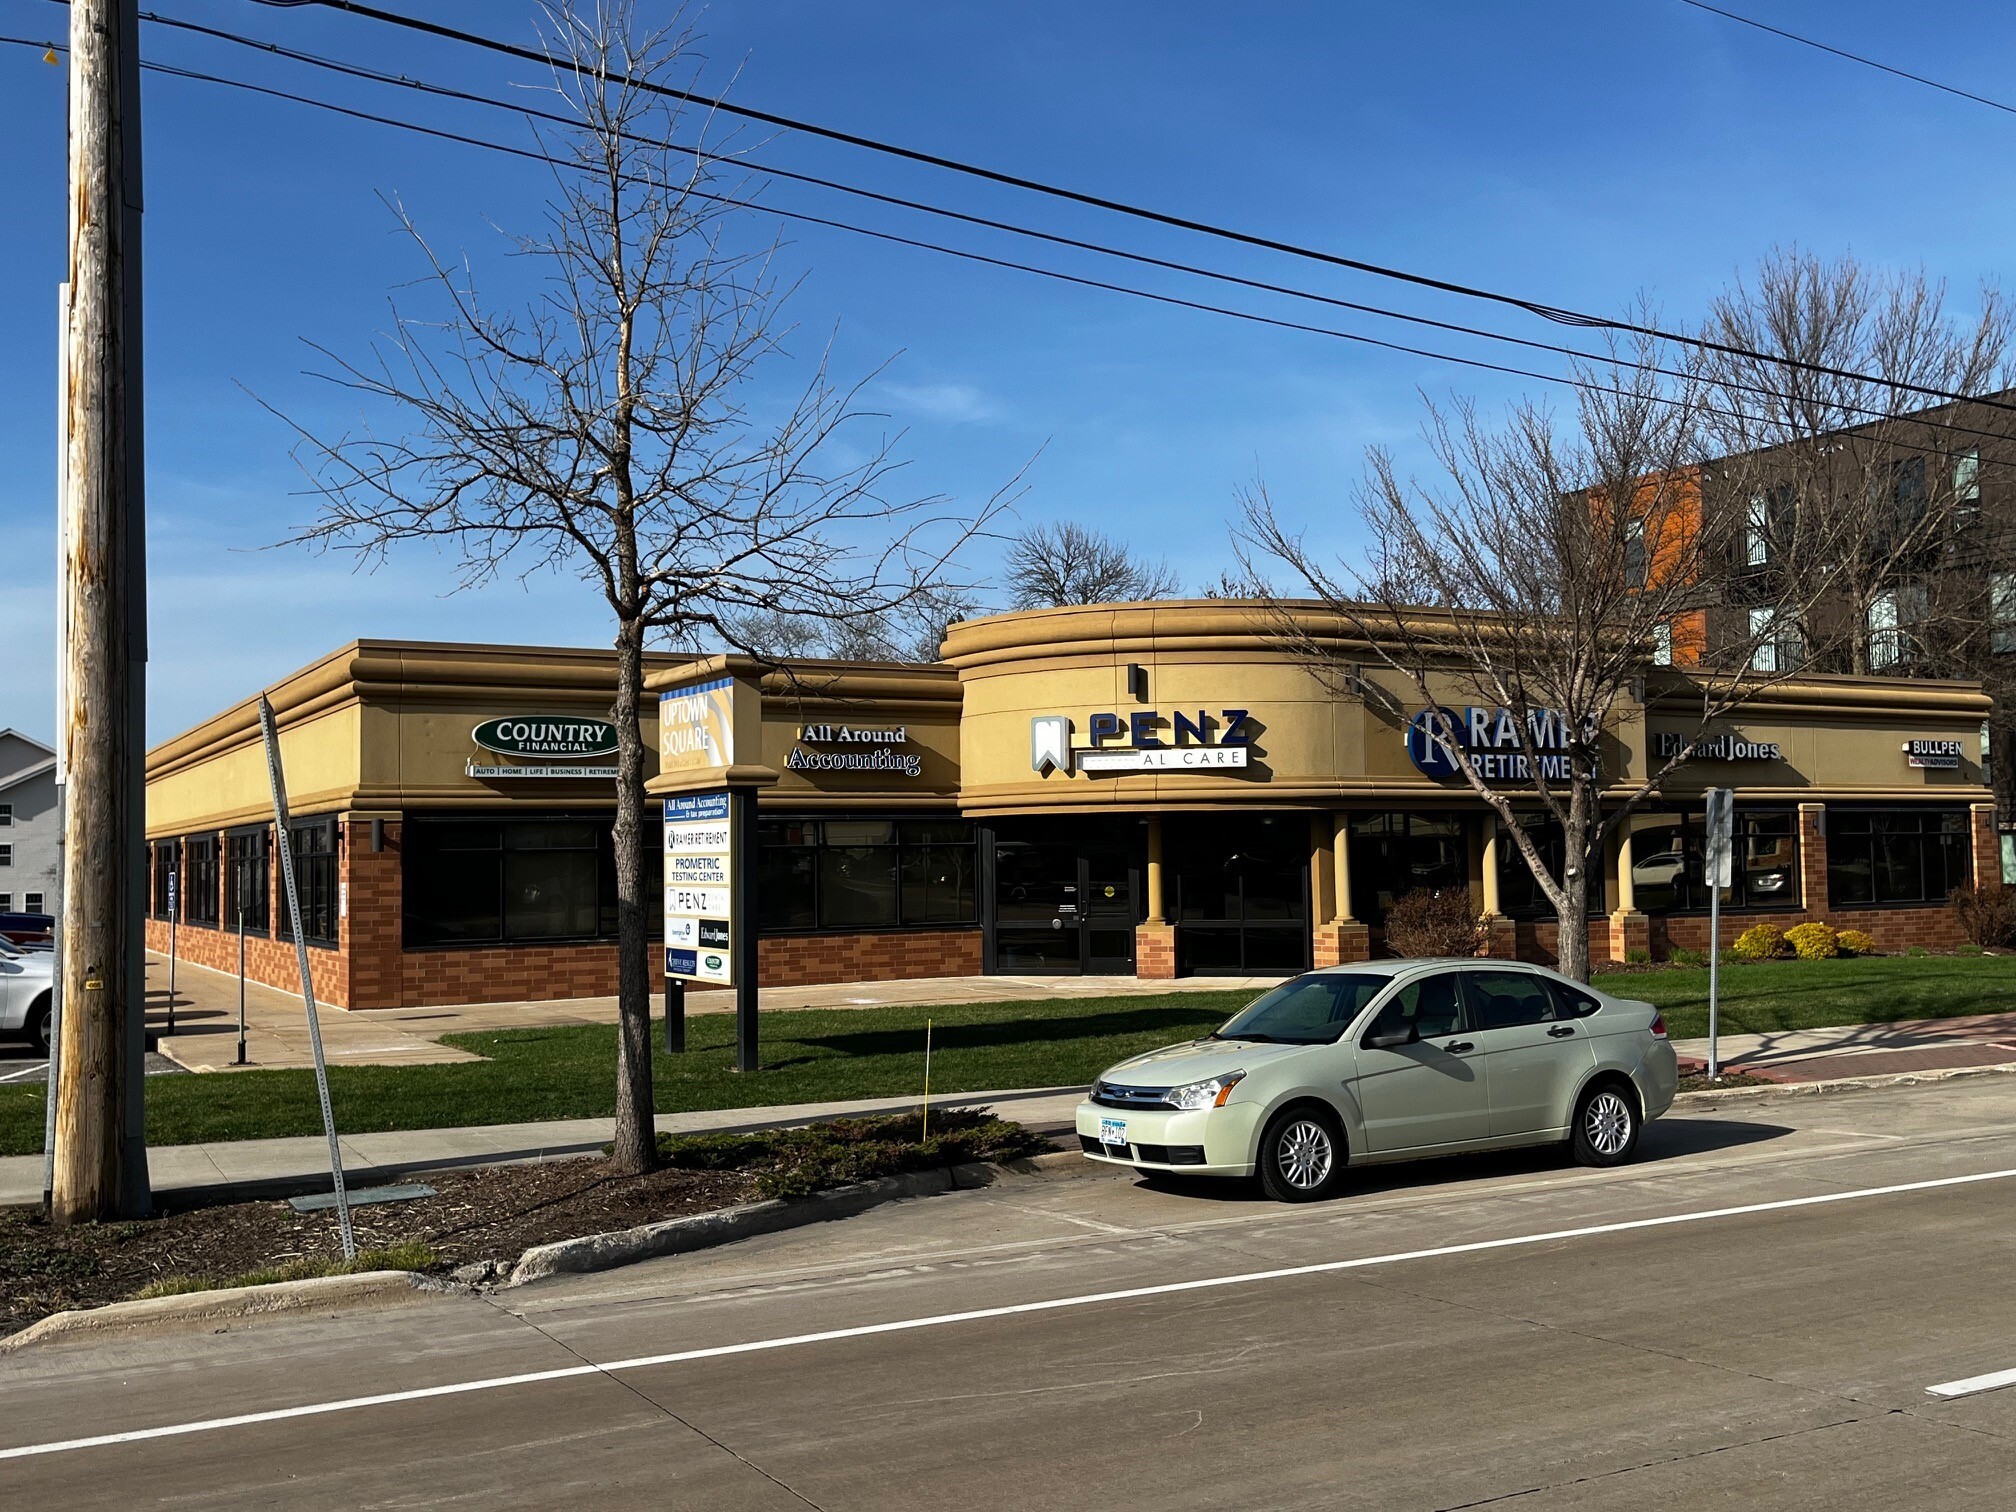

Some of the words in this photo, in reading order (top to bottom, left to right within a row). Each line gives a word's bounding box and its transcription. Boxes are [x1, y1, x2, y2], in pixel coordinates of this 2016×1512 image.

[663, 695, 708, 727] UPTOWN
[496, 722, 608, 742] COUNTRY
[802, 725, 833, 742] All
[837, 726, 907, 743] Around
[1089, 709, 1249, 747] PENZ
[518, 742, 588, 751] FINANCIAL
[663, 725, 709, 757] SQUARE
[1913, 741, 1963, 755] BULLPEN
[786, 747, 921, 777] Accounting
[1183, 752, 1239, 765] CARE
[667, 799, 676, 811] All
[676, 797, 696, 809] Around
[697, 795, 727, 809] Accounting
[698, 808, 724, 818] preparation
[695, 831, 728, 845] RETIREMENT
[675, 858, 720, 870] PROMETRIC
[672, 872, 698, 882] TESTING
[698, 872, 724, 882] CENTER
[678, 892, 707, 910] PENZ
